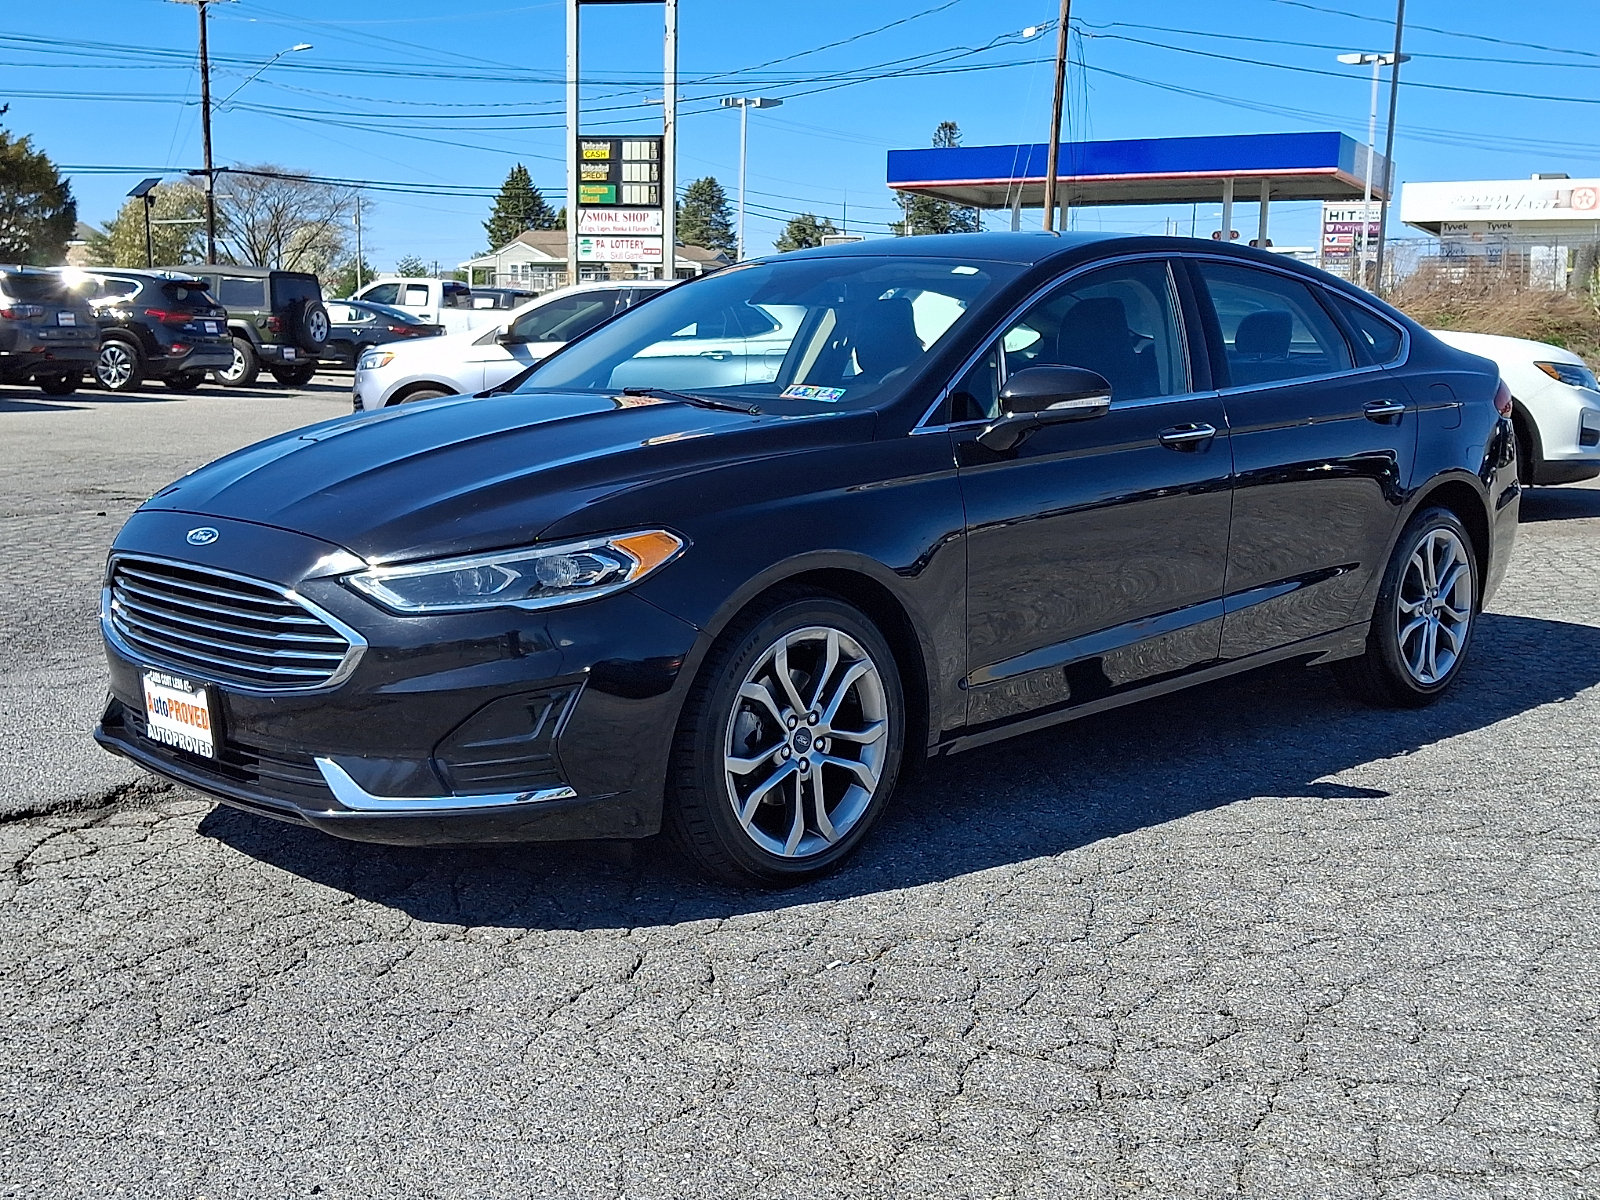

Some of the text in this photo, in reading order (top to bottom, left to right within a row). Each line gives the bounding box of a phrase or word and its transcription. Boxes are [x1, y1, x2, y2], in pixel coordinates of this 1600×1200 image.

[581, 141, 611, 150] Unleaded
[581, 163, 609, 173] Unleaded
[586, 212, 649, 222] SMOKE SHOP
[1329, 211, 1356, 221] HIT
[1443, 221, 1513, 232] Tyvek Tyvek
[596, 239, 645, 249] PA LOTTERY
[595, 252, 644, 260] PA Skill Game
[189, 529, 215, 543] Ford
[147, 691, 209, 730] AutoPROVED
[146, 723, 213, 758] AUTOPROVED
